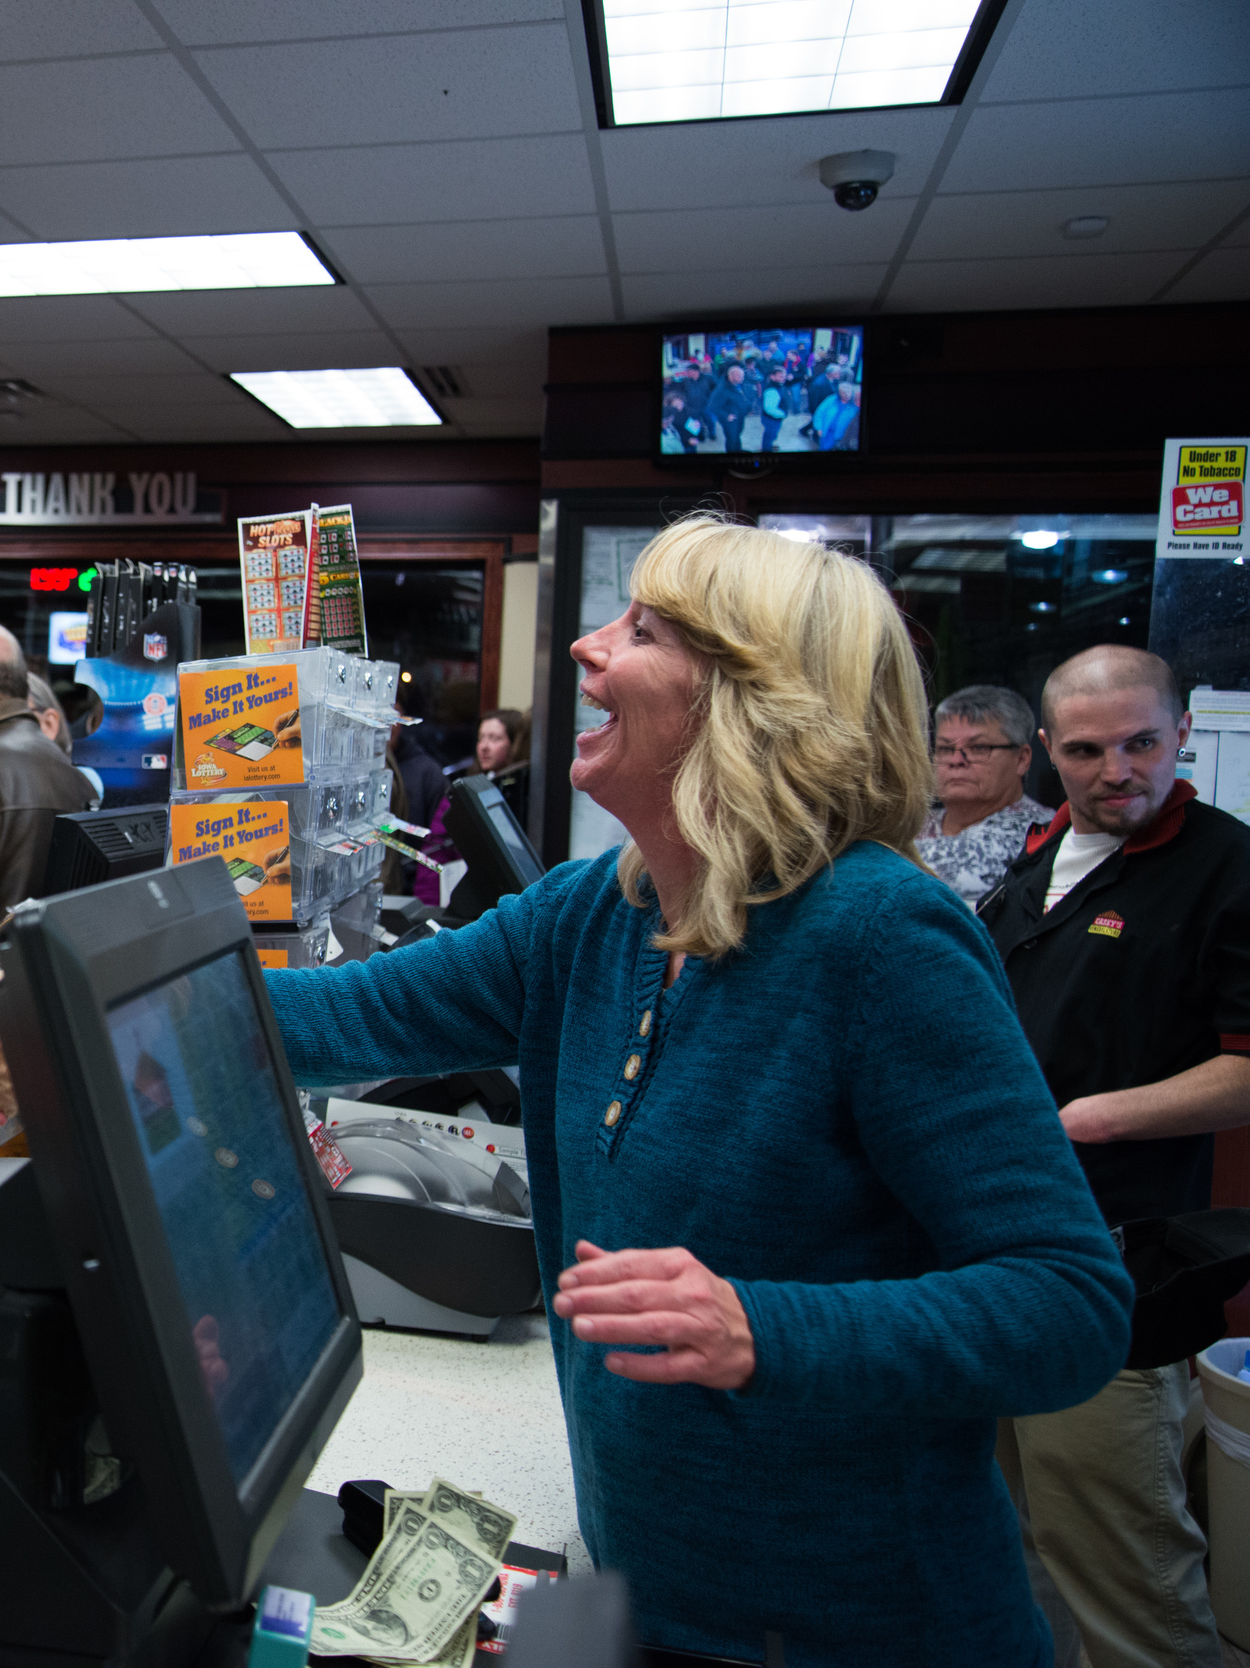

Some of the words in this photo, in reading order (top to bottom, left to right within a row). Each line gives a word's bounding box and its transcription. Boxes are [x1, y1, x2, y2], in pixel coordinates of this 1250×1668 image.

[1189, 450, 1221, 463] Under
[1224, 450, 1237, 462] 18
[1182, 465, 1196, 477] No
[1199, 465, 1241, 478] Tobacco
[1, 471, 116, 515] THANK
[128, 471, 198, 516] YOU
[1186, 486, 1229, 505] We
[1176, 500, 1239, 521] Card
[249, 523, 274, 538] HOT
[257, 533, 294, 548] SLOTS
[1167, 541, 1190, 550] Please
[1193, 541, 1209, 550] Have
[1212, 541, 1220, 550] ID
[1222, 541, 1243, 551] Ready
[148, 643, 167, 657] NFL
[204, 681, 243, 705] Sign
[246, 672, 277, 690] It...
[188, 707, 230, 730] Make
[232, 700, 245, 716] It
[245, 681, 293, 710] Yours!
[247, 766, 262, 774] Visit
[195, 816, 234, 838] Sign
[237, 808, 268, 826] It...
[178, 841, 220, 862] Make
[223, 834, 235, 850] It
[237, 818, 284, 845] Yours!
